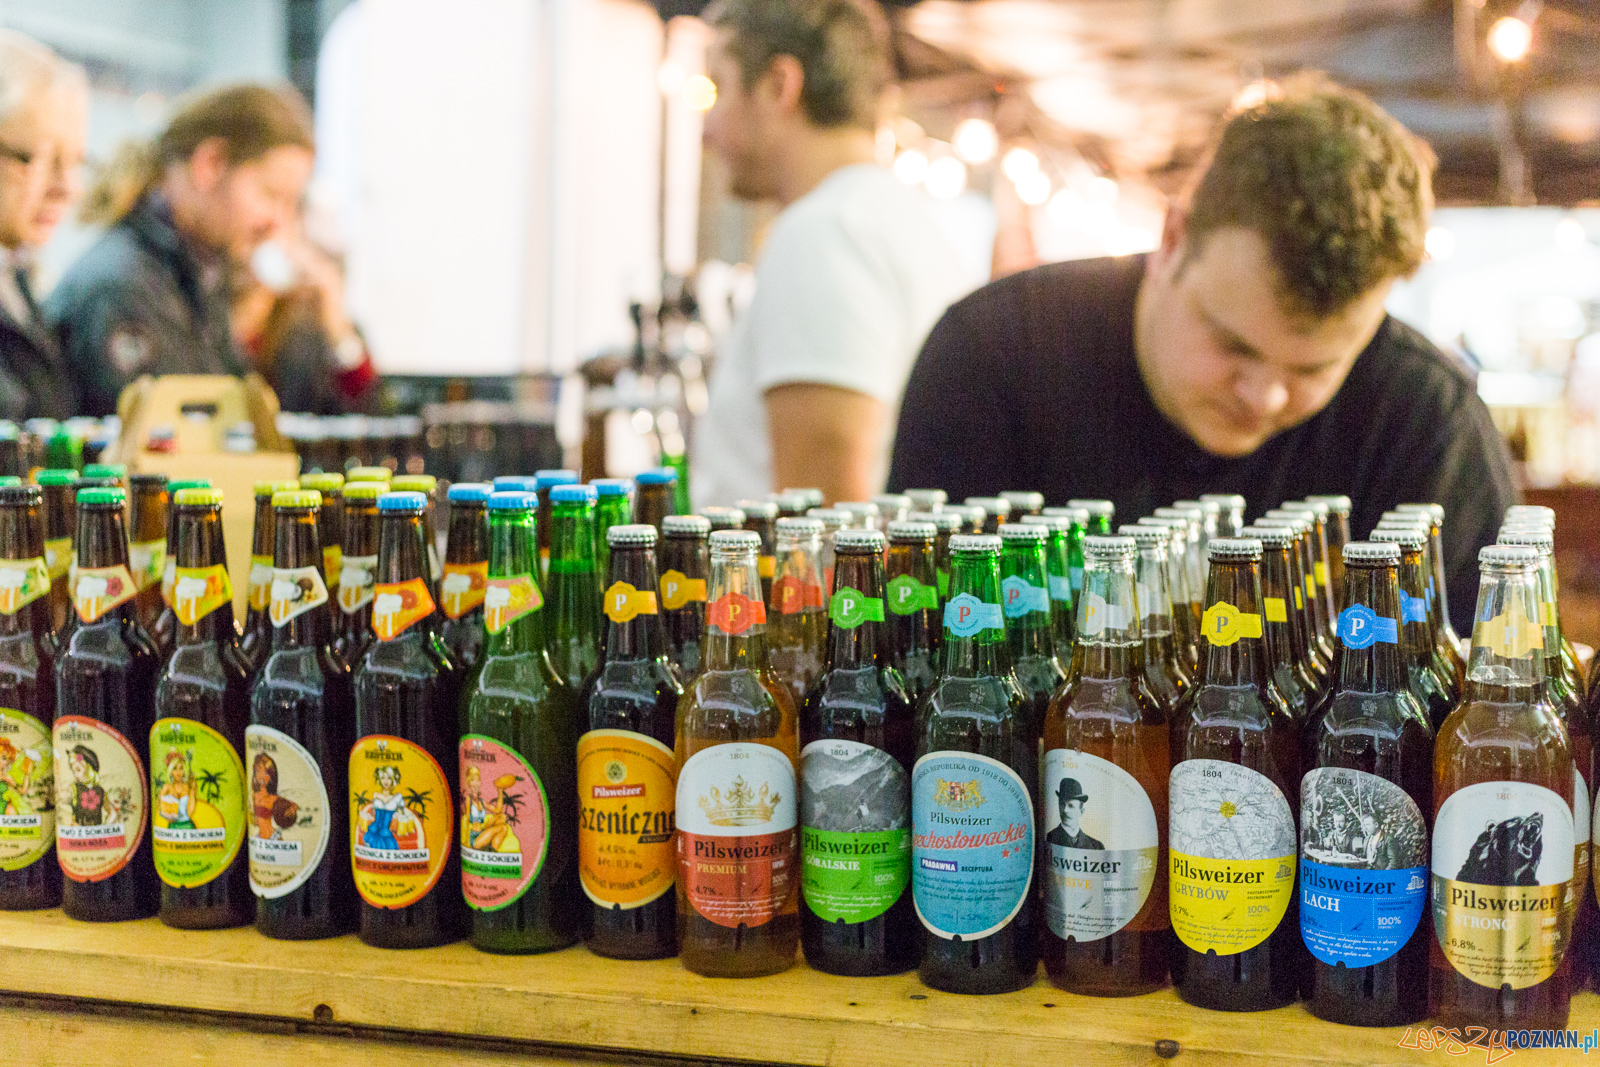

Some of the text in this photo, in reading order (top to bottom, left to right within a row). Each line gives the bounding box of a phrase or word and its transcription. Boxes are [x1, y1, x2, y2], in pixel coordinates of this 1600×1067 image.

[668, 582, 678, 598] P
[783, 586, 794, 602] P
[899, 586, 911, 602] P
[1008, 589, 1020, 604] P
[615, 594, 626, 610] P
[842, 599, 854, 616] P
[728, 604, 742, 621] P
[958, 606, 970, 622] P
[1086, 606, 1096, 622] P
[1216, 616, 1228, 633] P
[1350, 618, 1364, 636] P
[1504, 626, 1518, 644] P
[1062, 760, 1079, 770] 1804
[982, 768, 998, 780] 1918
[998, 776, 1008, 787] DO
[1202, 770, 1222, 778] 1804
[1333, 776, 1352, 786] 1804
[594, 786, 642, 797] Pilsweizer
[1496, 792, 1518, 800] 1804
[930, 812, 992, 826] Pilsweizer
[265, 842, 298, 850] SOKIEM
[694, 840, 783, 860] Pilsweizer
[804, 832, 890, 855] Pilsweizer
[696, 863, 748, 874] PREMIUM
[922, 859, 956, 872] PRADAWNA
[1173, 858, 1264, 884] Pilsweizer
[1303, 866, 1396, 894] Pilsweizer
[1174, 881, 1230, 902] GRYBÓW
[1304, 890, 1340, 912] LACH
[1452, 888, 1558, 912] Pilsweizer
[1248, 904, 1270, 914] 100%
[1378, 916, 1402, 926] 100%
[1454, 912, 1512, 930] STRONG
[1452, 938, 1476, 950] 6,8%
